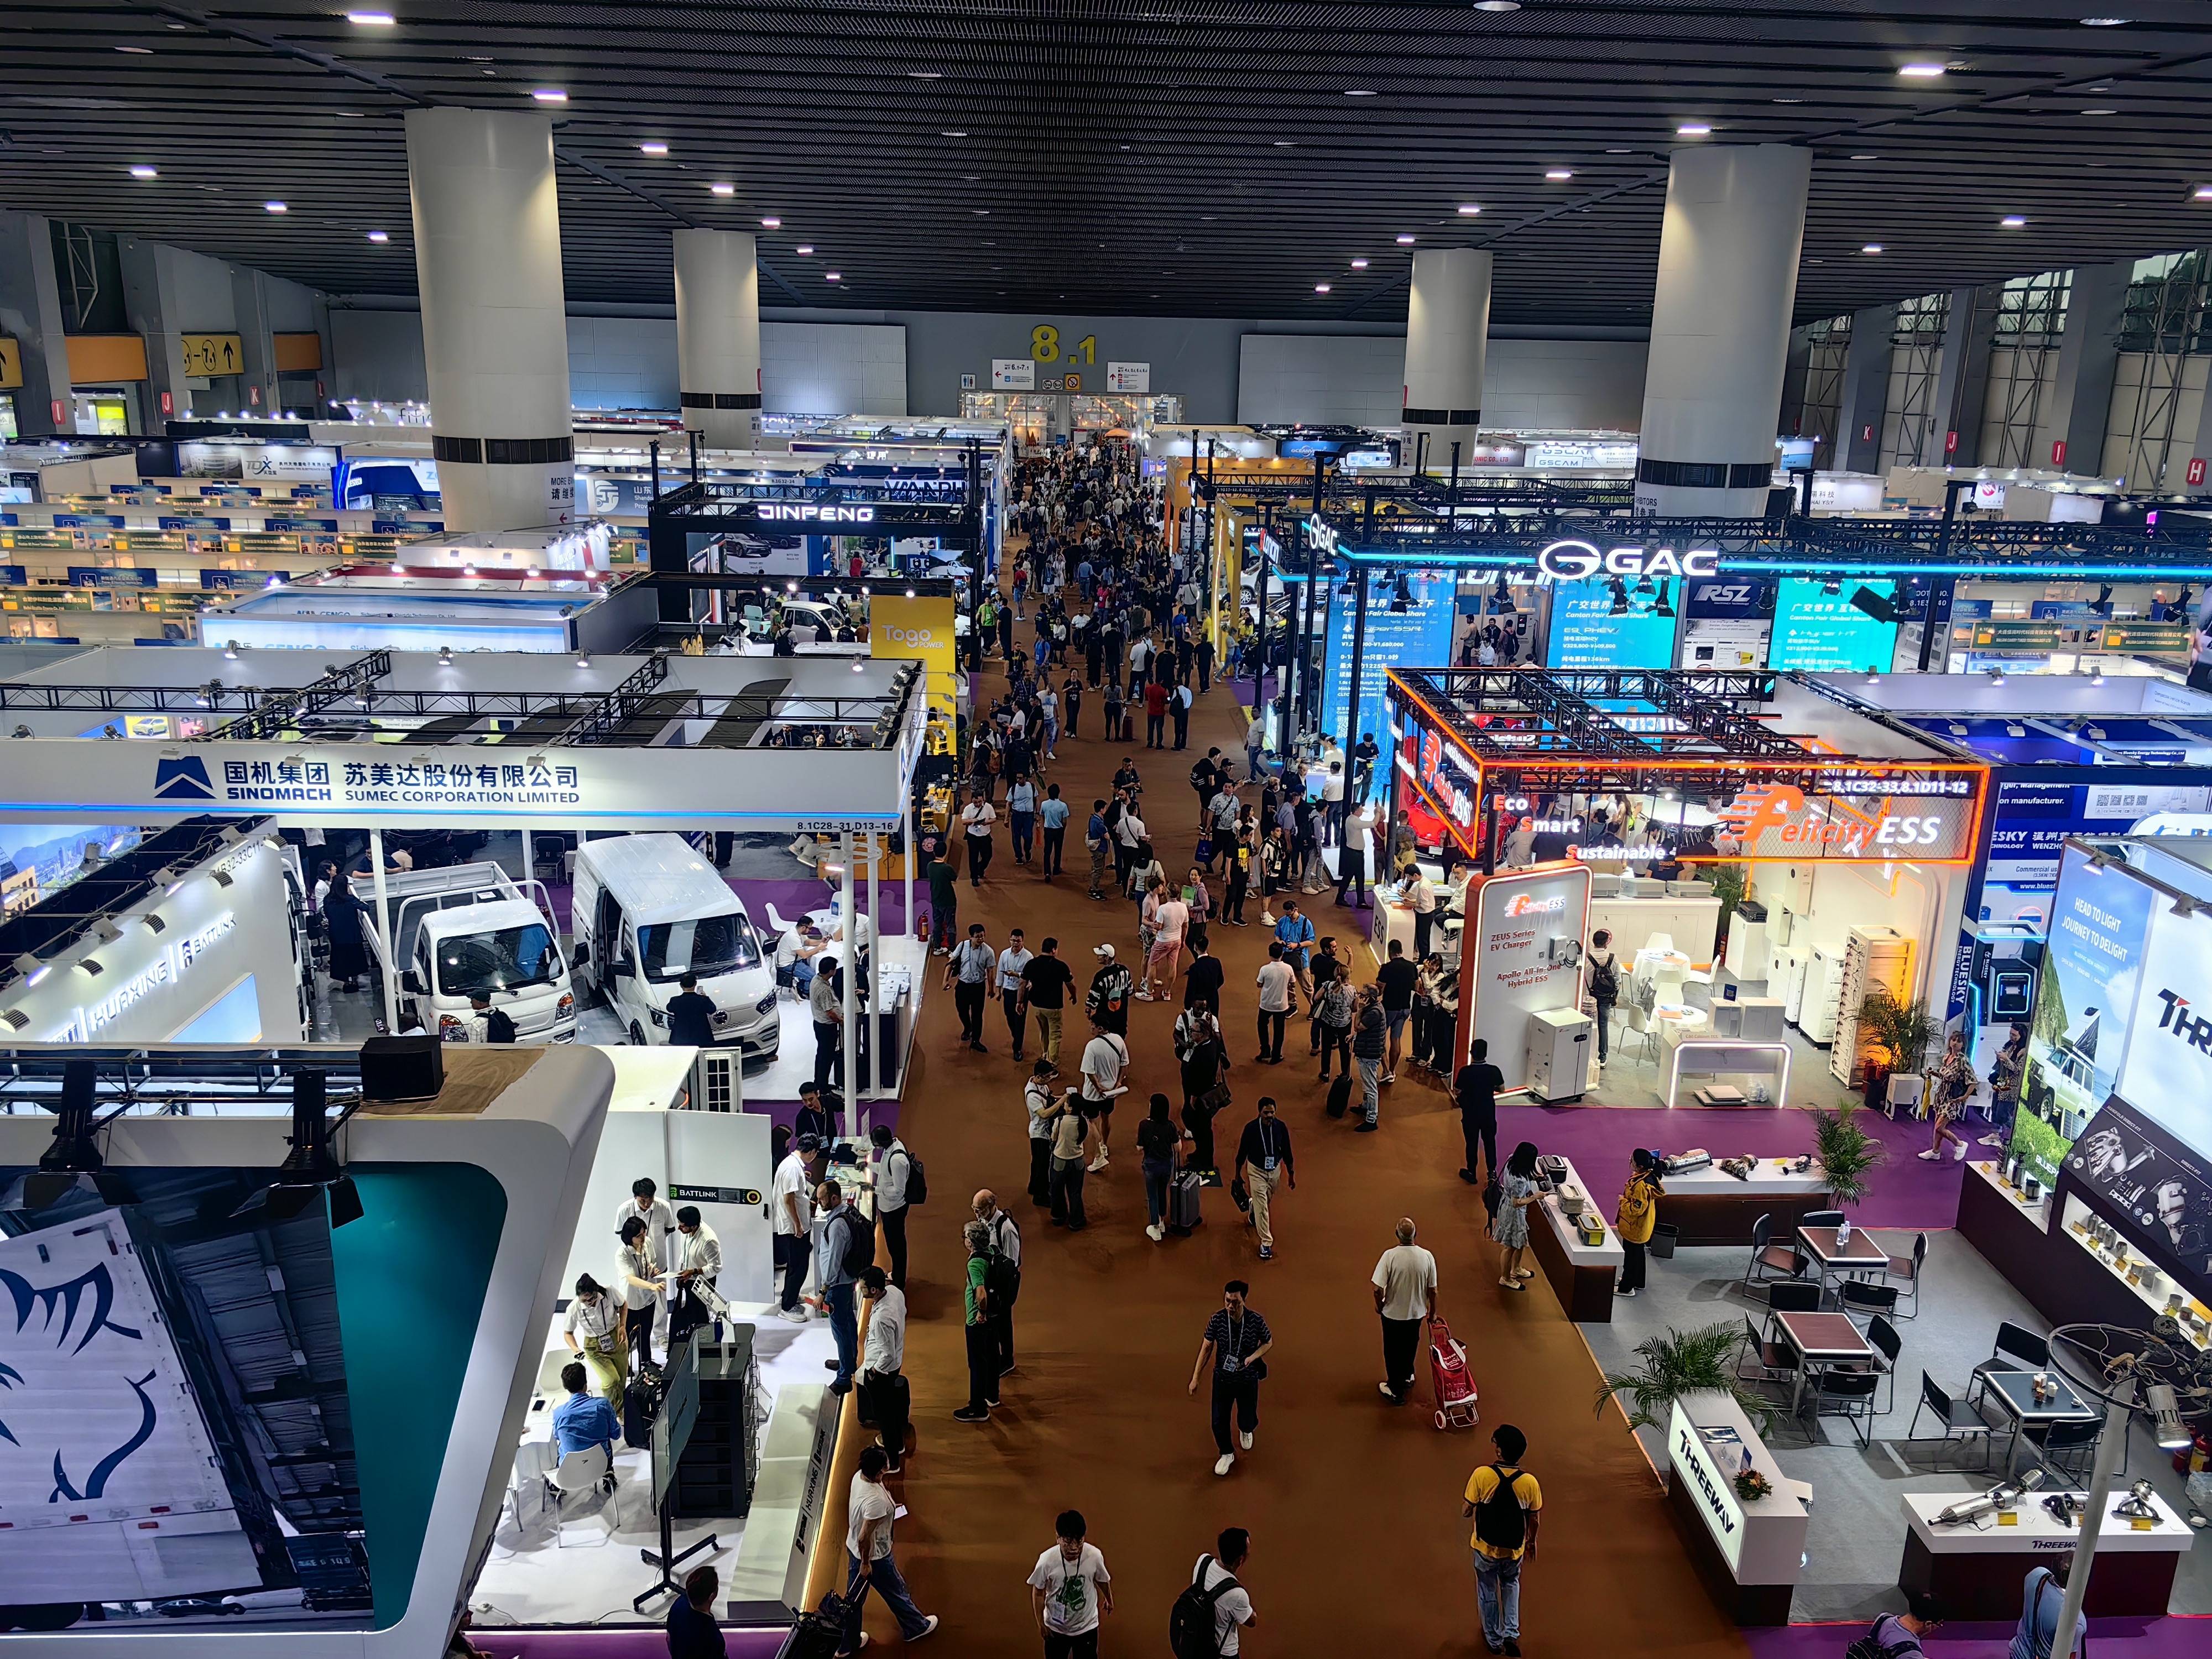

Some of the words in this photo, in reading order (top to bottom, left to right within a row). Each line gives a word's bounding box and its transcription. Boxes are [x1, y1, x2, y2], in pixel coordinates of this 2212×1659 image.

[1031, 325, 1095, 364] 8.1
[252, 388, 258, 403] K
[1863, 426, 1871, 440] K
[1948, 434, 1955, 449] J
[2188, 462, 2203, 482] H
[551, 477, 567, 486] MORE
[758, 505, 873, 521] JINPENG
[1319, 523, 1338, 556] GAC
[1605, 549, 1718, 576] GAC
[1694, 585, 1752, 602] RSZ
[1344, 598, 1388, 608] 广世界
[1567, 600, 1610, 609] 广交世界
[881, 624, 932, 648] Togo
[223, 761, 330, 785] 国机集团
[343, 763, 578, 789] 苏美达股份有限公司
[227, 787, 332, 800] SINOMACH
[346, 790, 399, 802] SUMEC
[402, 791, 514, 803] CORPORATION
[518, 792, 580, 804] LIMITED
[1494, 795, 1528, 812] Eco
[797, 822, 894, 830] 8.1C28-31,D13-16
[1520, 816, 1581, 833] Smart
[1876, 816, 1942, 844] ESS
[1566, 844, 1666, 859] Sustainable
[1548, 898, 1566, 909] ESS
[2074, 896, 2091, 917] HEAD
[2092, 906, 2101, 922] TO
[2101, 911, 2122, 933] LIGHT
[1491, 932, 1511, 942] ZEUS
[1512, 929, 1536, 938] Series
[2061, 915, 2091, 941] JOURNEY
[2091, 930, 2099, 946] TO
[2099, 936, 2128, 962] DELIGHT
[1490, 943, 1500, 952] EV
[1503, 939, 1532, 950] Charger
[1496, 970, 1521, 981] Apollo
[1524, 964, 1562, 975] All-in-One
[1955, 946, 1973, 1004] BLUESKY
[1508, 978, 1533, 989] Hybrid
[1535, 974, 1548, 983] ESS
[1950, 967, 1960, 1003] TECHNOLOGY
[2180, 1159, 2202, 1176] DIRECT-FIT
[679, 1190, 717, 1198] BATTLINK
